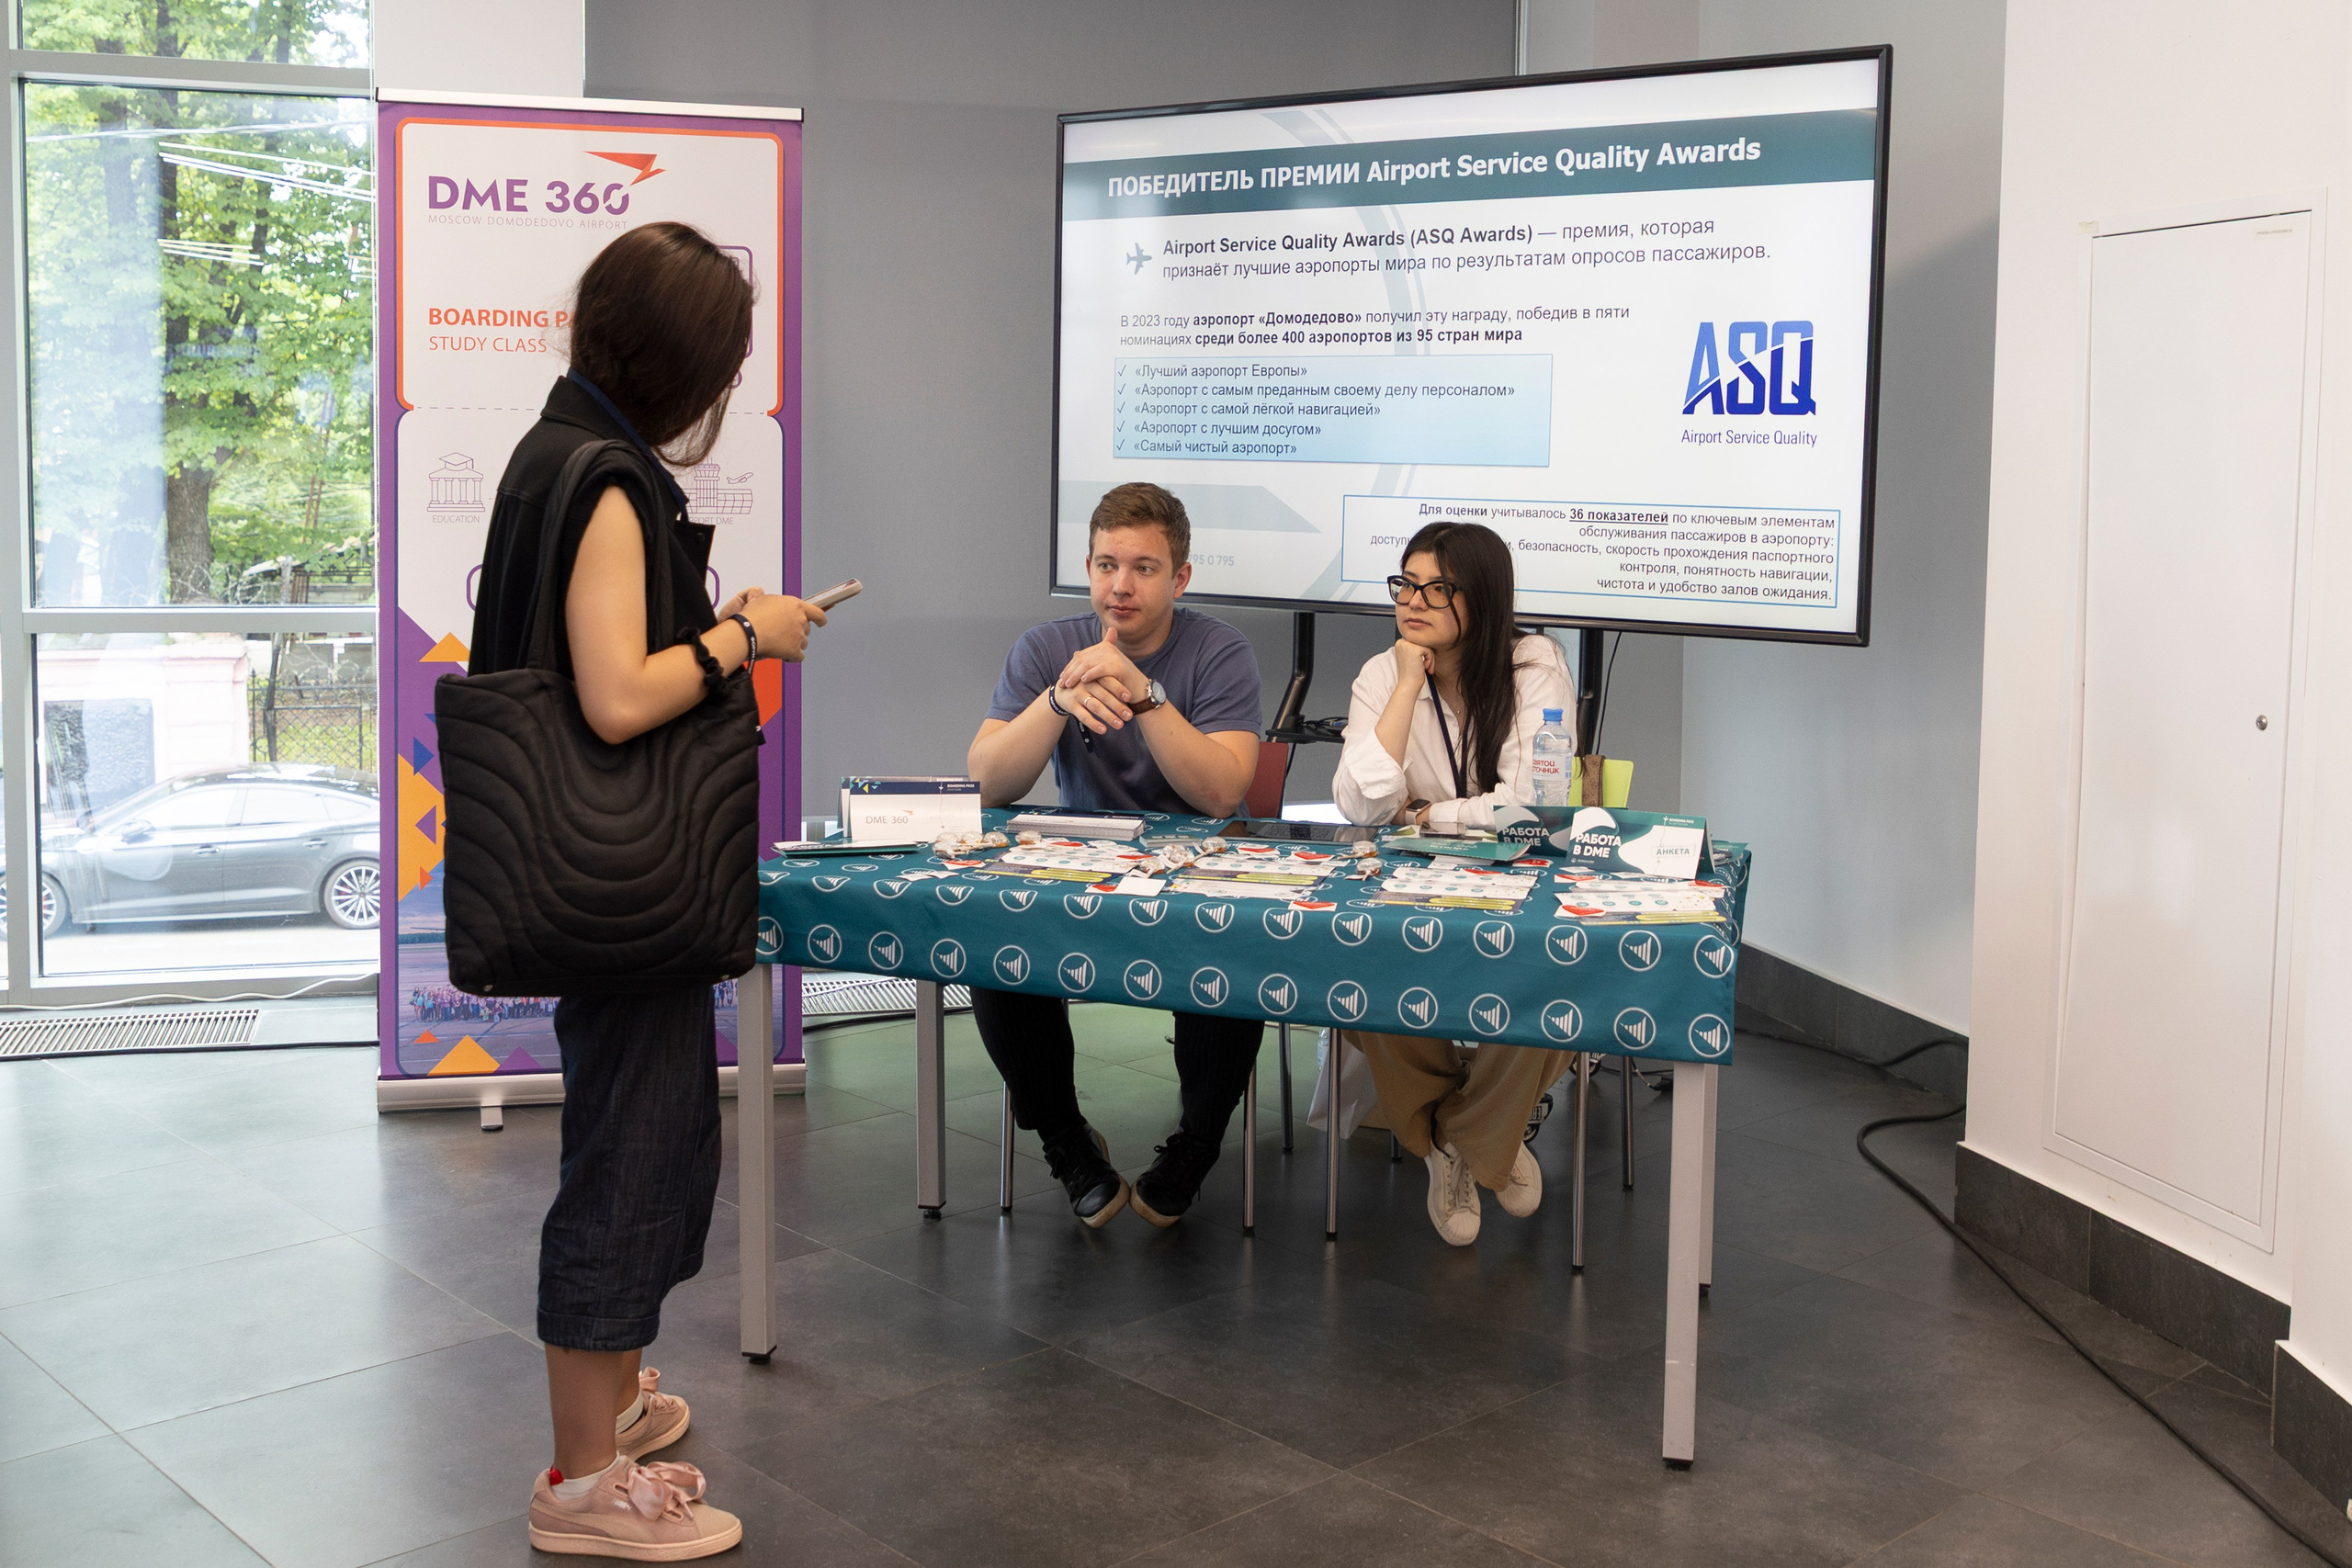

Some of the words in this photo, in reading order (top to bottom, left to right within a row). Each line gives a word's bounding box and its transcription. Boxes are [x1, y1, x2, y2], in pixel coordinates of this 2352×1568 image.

[1108, 169, 1255, 198] ПОБЕДИТЕЛЬ
[1261, 162, 1360, 188] ПРЕМИИ
[1366, 157, 1451, 186] Airport
[1457, 152, 1547, 176] Service
[1555, 145, 1650, 176] Quality
[1657, 137, 1760, 165] Awards
[428, 175, 528, 212] DME
[545, 181, 629, 215] 360
[427, 214, 482, 225] MOSCOW
[487, 216, 574, 228] DOMODEDOVO
[579, 219, 628, 230] AIRPORT
[1163, 239, 1216, 257] Airport
[1220, 236, 1276, 253] Service
[1282, 233, 1338, 252] Quality
[1342, 231, 1405, 248] Awards
[1411, 228, 1454, 249] (ASQ
[1460, 224, 1532, 244] Awards)
[1563, 224, 1634, 243] премия,
[1641, 220, 1713, 238] которая
[1163, 263, 1229, 281] признаёт
[1233, 263, 1290, 279] лучшие
[1295, 259, 1380, 276] аэропорты
[1385, 258, 1426, 274] мира
[1432, 257, 1451, 269] по
[1457, 253, 1565, 272] результатам
[1572, 250, 1645, 268] опросов
[1652, 245, 1770, 264] пассажиров.
[428, 308, 549, 328] BOARDING
[1121, 315, 1128, 327] В
[1132, 314, 1160, 327] 2023
[1164, 317, 1190, 329] году
[1193, 315, 1255, 329] аэропорт
[1259, 312, 1362, 327] «Домодедово»
[1366, 312, 1421, 325] получил
[1426, 311, 1448, 325] эту
[1453, 310, 1510, 323] награду,
[1517, 306, 1577, 321] победив
[1583, 309, 1590, 319] в
[1596, 308, 1629, 318] пяти
[429, 336, 487, 351] STUDY
[492, 337, 548, 353] CLASS
[1121, 335, 1192, 347] номинациях
[1195, 334, 1234, 347] среди
[1238, 331, 1278, 344] более
[1282, 331, 1305, 344] 400
[1309, 333, 1392, 346] аэропортов
[1396, 332, 1412, 342] из
[1417, 329, 1432, 342] 95
[1438, 331, 1479, 344] стран
[1485, 330, 1521, 344] мира
[1136, 365, 1187, 379] «Лучший
[1191, 367, 1248, 379] аэропорт
[1252, 364, 1307, 379] Европы»
[1681, 320, 1816, 416] ASQ
[1135, 383, 1198, 399] «Аэропорт
[1202, 386, 1208, 396] с
[1212, 386, 1253, 396] самым
[1257, 386, 1329, 399] преданным
[1334, 386, 1382, 399] своему
[1385, 386, 1418, 399] делу
[1422, 386, 1515, 399] персоналом»
[1135, 401, 1198, 417] «Аэропорт
[1201, 405, 1208, 414] с
[1211, 402, 1249, 414] самой
[1252, 402, 1294, 414] лёгкой
[1298, 402, 1380, 418] навигацией»
[1135, 421, 1197, 436] «Аэропорт
[1201, 424, 1207, 434] с
[1211, 424, 1259, 437] лучшим
[1262, 425, 1321, 438] досугом»
[1681, 429, 1722, 446] Airport
[1725, 430, 1770, 445] Service
[1774, 430, 1817, 447] Quality
[1134, 439, 1182, 452] «Самый
[1185, 441, 1228, 453] чистый
[1232, 444, 1296, 457] аэропорт»
[432, 514, 481, 524] EDUCATION
[1419, 503, 1442, 516] Для
[1445, 507, 1487, 517] оценки
[1491, 508, 1566, 519] учитывалось
[1569, 508, 1585, 524] 36
[1587, 511, 1669, 526] показателей
[1672, 514, 1687, 524] по
[1691, 515, 1757, 525] ключевым
[1761, 517, 1835, 528] элементам
[1579, 525, 1667, 540] обслуживания
[1671, 531, 1747, 545] пассажиров
[1750, 534, 1758, 543] в
[1761, 535, 1834, 548] аэропорту:
[1217, 555, 1234, 567] 795
[1519, 539, 1601, 556] безопасность,
[1606, 546, 1659, 558] скорость
[1664, 547, 1747, 560] прохождения
[1752, 551, 1834, 565] паспортного
[1620, 563, 1679, 576] контроля,
[1684, 566, 1756, 578] понятность
[1760, 570, 1832, 583] навигации,
[1597, 580, 1645, 590] чистота
[1648, 581, 1656, 591] и
[1659, 581, 1717, 593] удобство
[1721, 585, 1758, 596] залов
[1762, 588, 1831, 600] ожидания.
[865, 816, 888, 824] DME
[891, 816, 909, 824] 360
[1502, 827, 1550, 837] РАБОТА
[1575, 832, 1622, 847] РАБОТА
[1514, 837, 1542, 847] DME
[1572, 845, 1581, 855] В
[1583, 846, 1611, 858] DME
[1656, 848, 1690, 856] АНКЕТА
